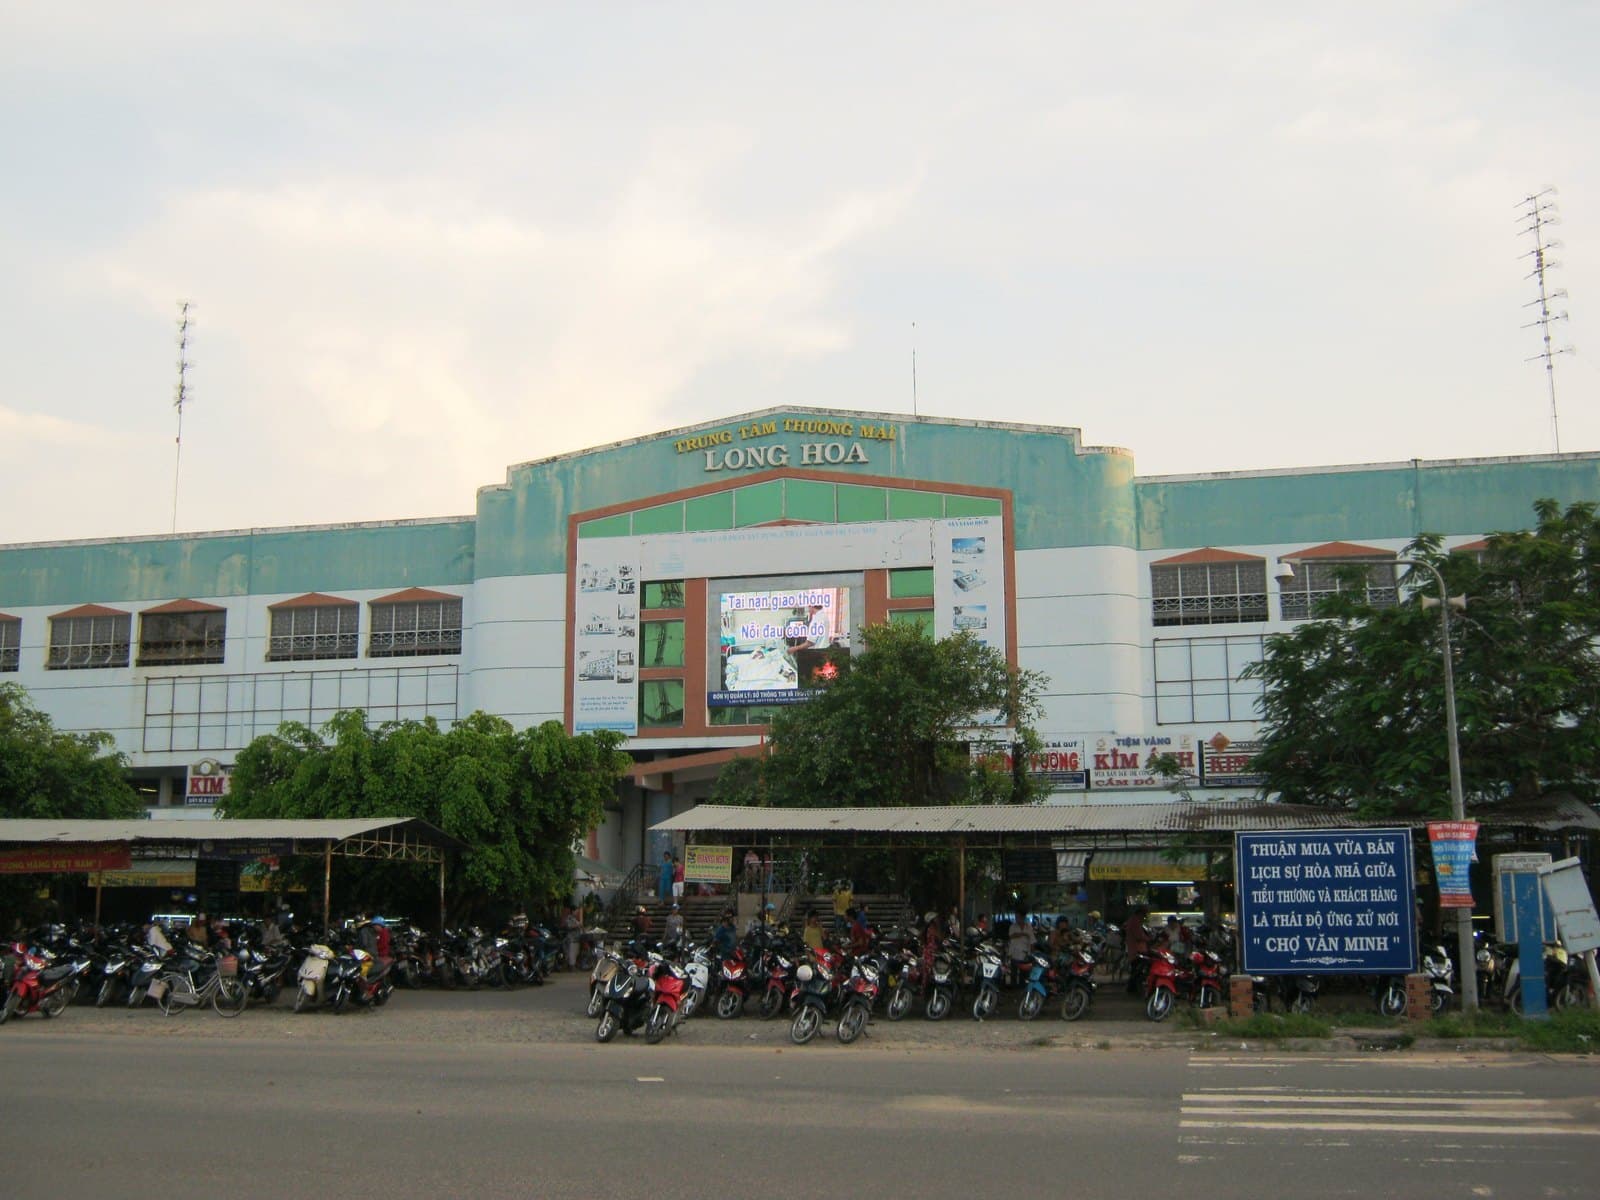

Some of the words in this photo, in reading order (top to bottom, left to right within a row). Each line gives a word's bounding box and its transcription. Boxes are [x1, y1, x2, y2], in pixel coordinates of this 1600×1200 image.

[673, 431, 732, 454] TRUNG
[738, 420, 777, 440] TÂM
[704, 444, 790, 471] LONG
[800, 441, 869, 466] HOA
[728, 595, 745, 608] Tai
[748, 596, 768, 611] nạn
[772, 595, 796, 610] giao
[799, 592, 831, 608] thông
[763, 624, 783, 638] đau
[190, 777, 225, 795] KIM
[1250, 841, 1296, 859] THUẬN
[1300, 843, 1332, 856] MUA
[1334, 839, 1364, 855] VỪA
[1367, 839, 1395, 854] BÁN
[1251, 866, 1281, 882] LỊCH
[1284, 864, 1301, 881] SỰ
[1304, 862, 1332, 878] HÒA
[1334, 862, 1361, 878] NHÃ
[1365, 862, 1396, 878] GIỮA
[1252, 884, 1275, 903] TIỂU
[1277, 887, 1315, 903] THƯƠNG
[1318, 886, 1332, 902] VÀ
[1333, 886, 1368, 902] KHÁCH
[1370, 886, 1398, 902] HÀNG
[1253, 911, 1269, 927] LÀ
[1272, 911, 1302, 927] THÁI
[1306, 911, 1323, 929] ĐỘ
[1327, 910, 1352, 926] ỨNG
[1356, 909, 1374, 926] XỬ
[1377, 911, 1399, 926] NƠI
[1265, 935, 1300, 955] CHỢ
[1305, 934, 1339, 951] VĂN
[1344, 937, 1389, 951] MINH
